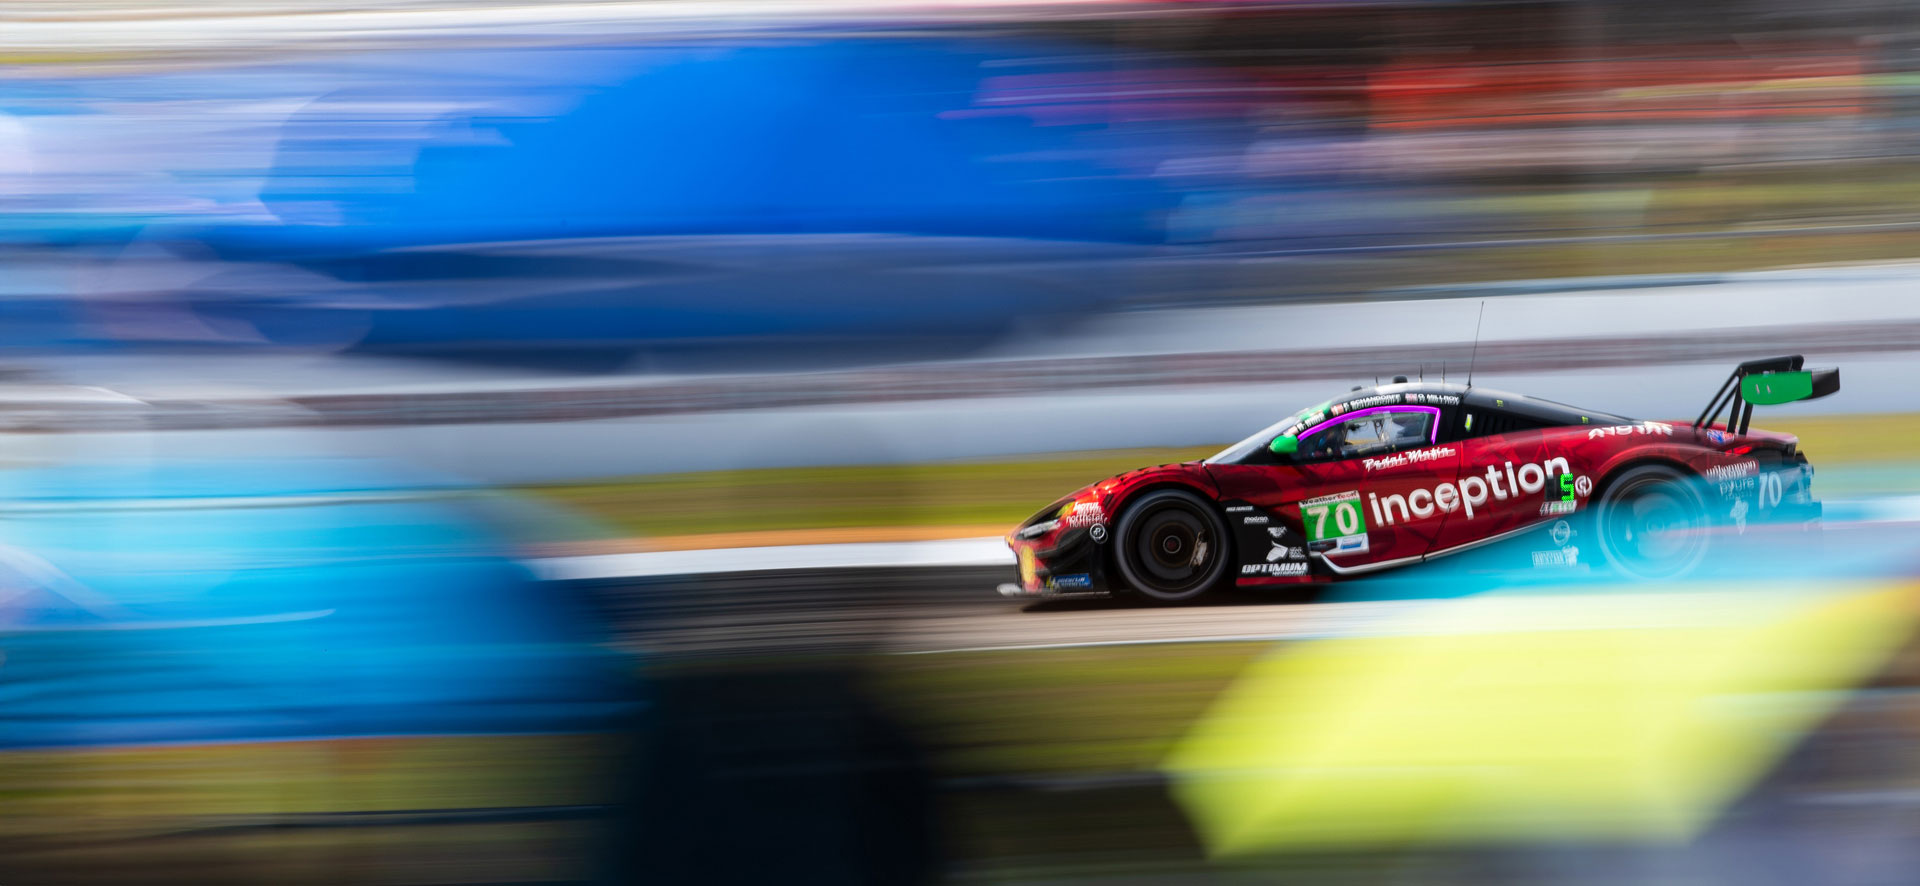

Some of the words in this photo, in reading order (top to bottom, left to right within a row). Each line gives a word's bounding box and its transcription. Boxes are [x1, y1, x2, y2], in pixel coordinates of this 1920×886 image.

[1368, 456, 1570, 527] inception
[1759, 472, 1782, 510] 70
[1307, 502, 1359, 540] 70
[1241, 562, 1308, 575] OPTIMUM
